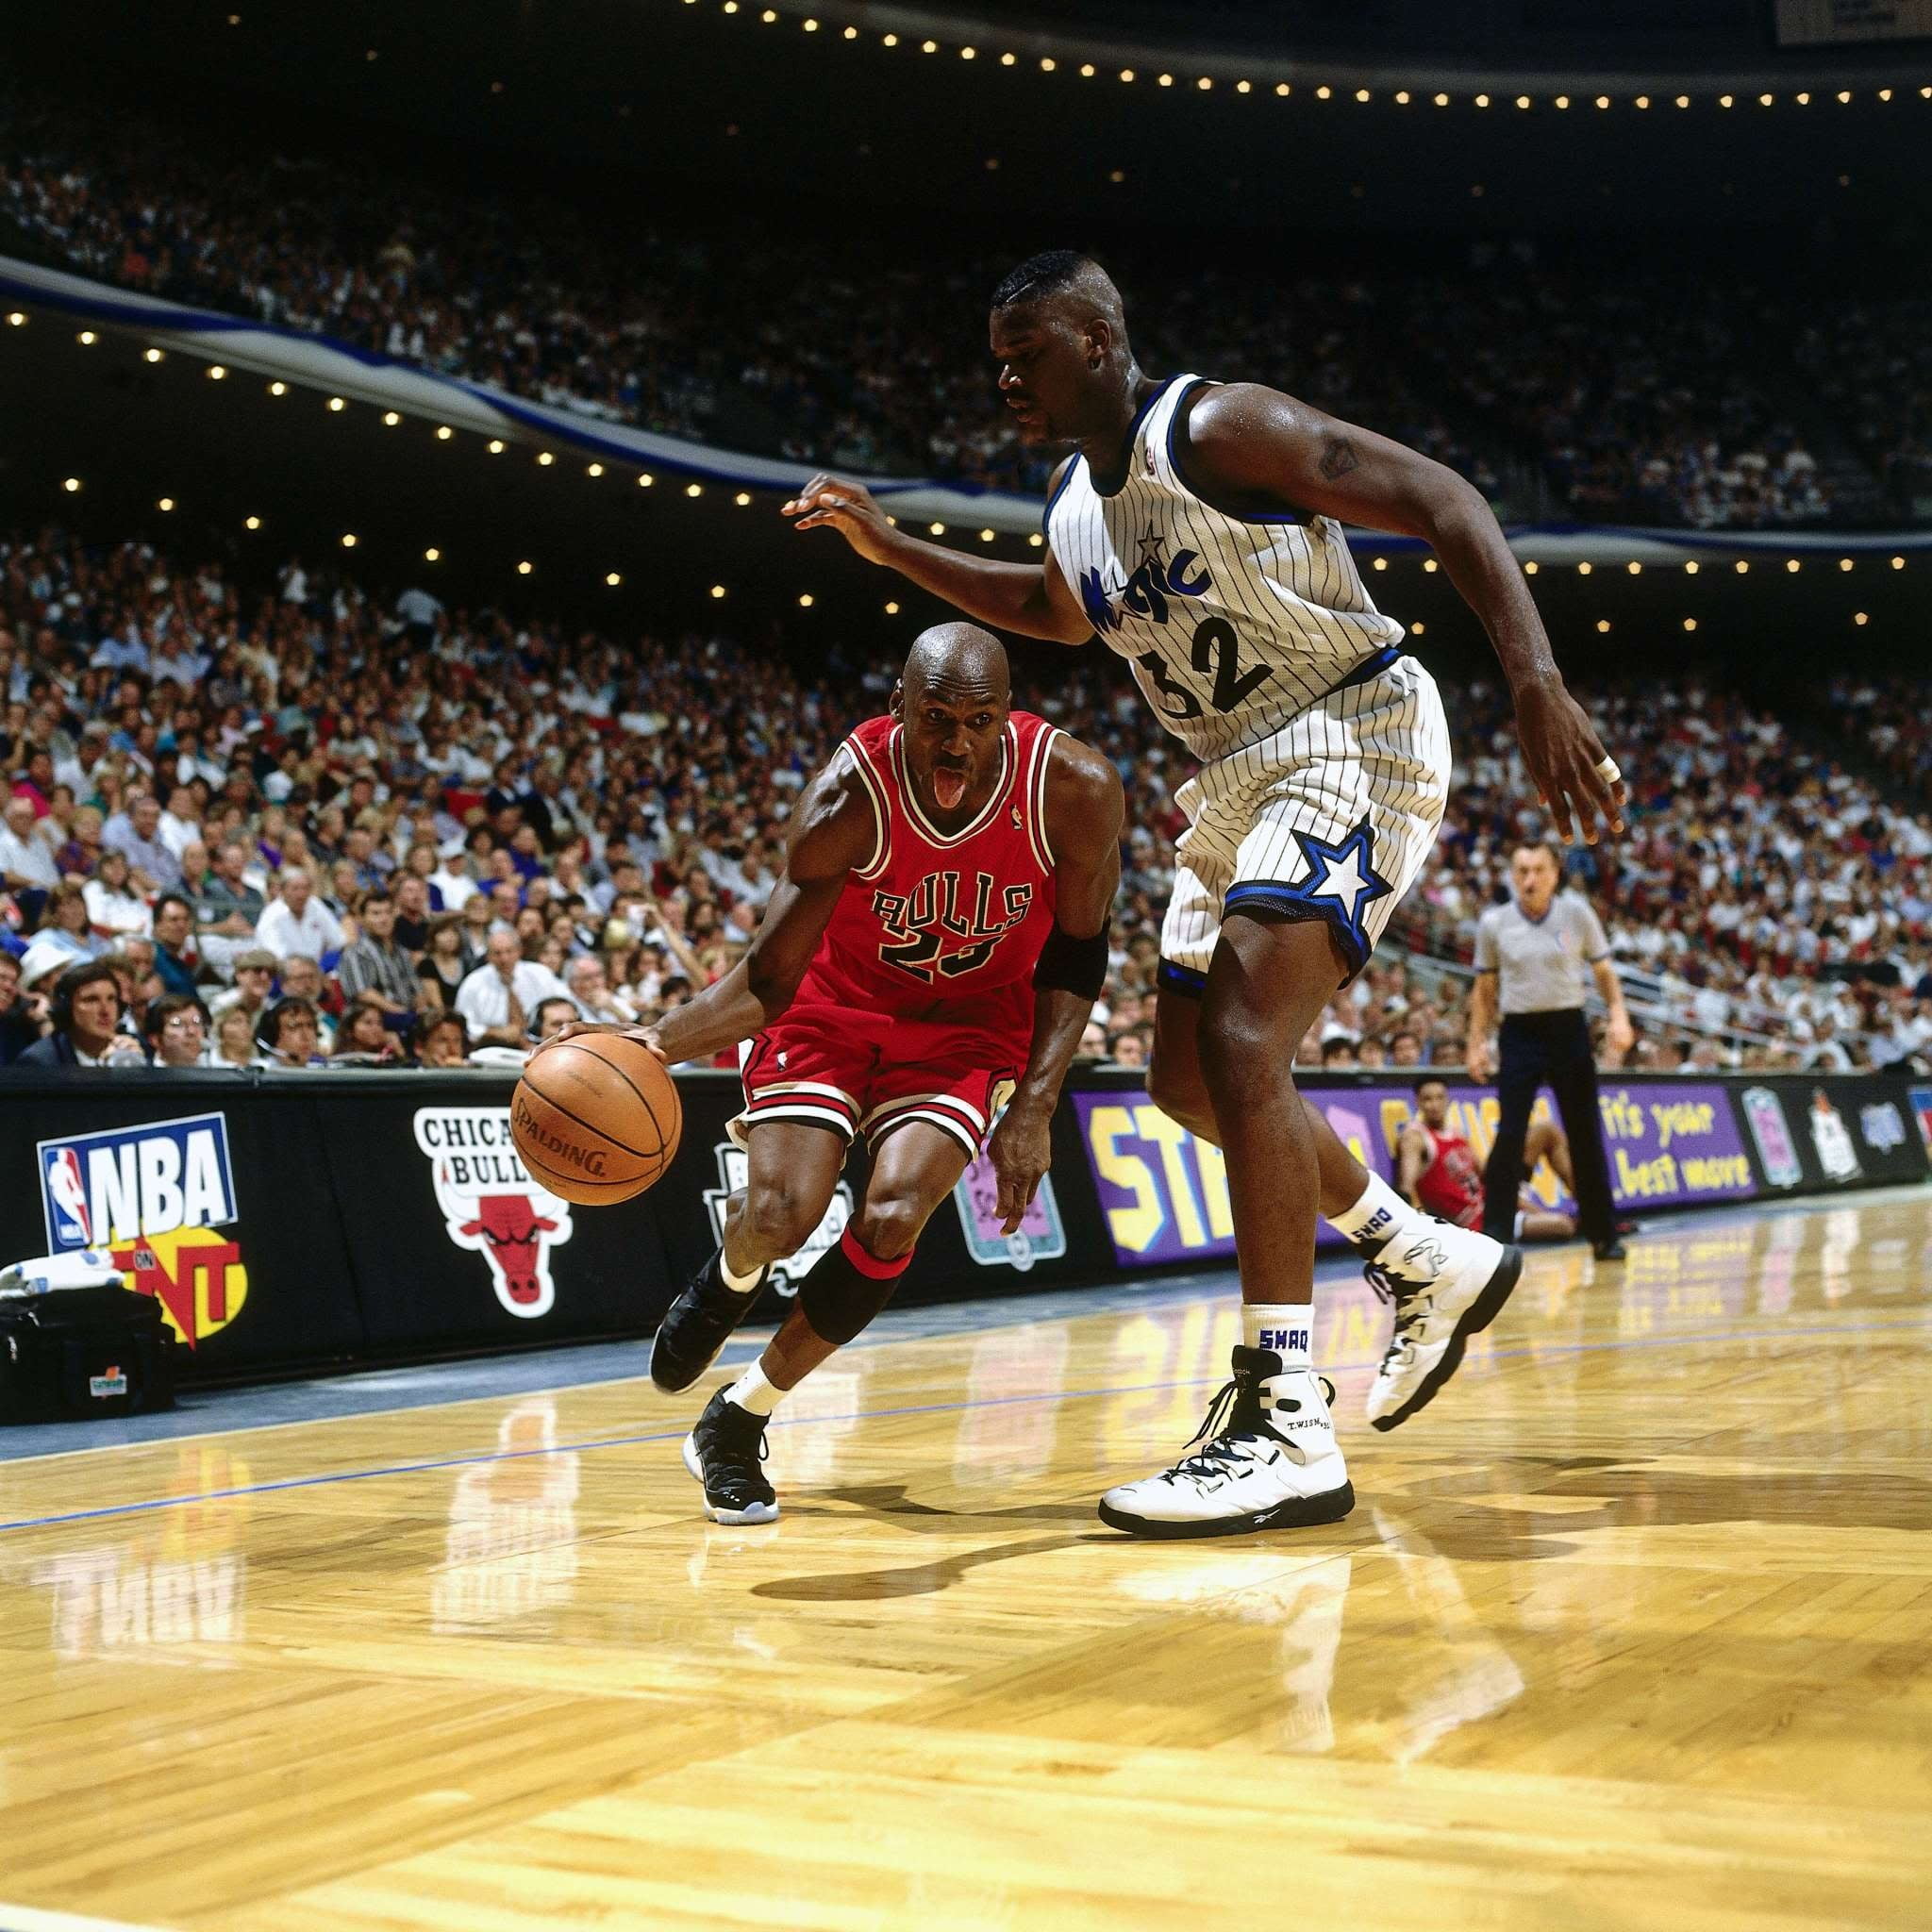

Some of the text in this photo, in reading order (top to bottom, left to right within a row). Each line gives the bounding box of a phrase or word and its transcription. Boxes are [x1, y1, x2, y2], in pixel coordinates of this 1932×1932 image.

[1136, 617, 1274, 720] 32
[872, 871, 1033, 938] BULLS
[877, 924, 1008, 985] 23
[424, 1118, 512, 1147] CHICA
[88, 1128, 228, 1247] NBA
[451, 1156, 527, 1184] BULL
[1258, 1329, 1308, 1353] SHAQ
